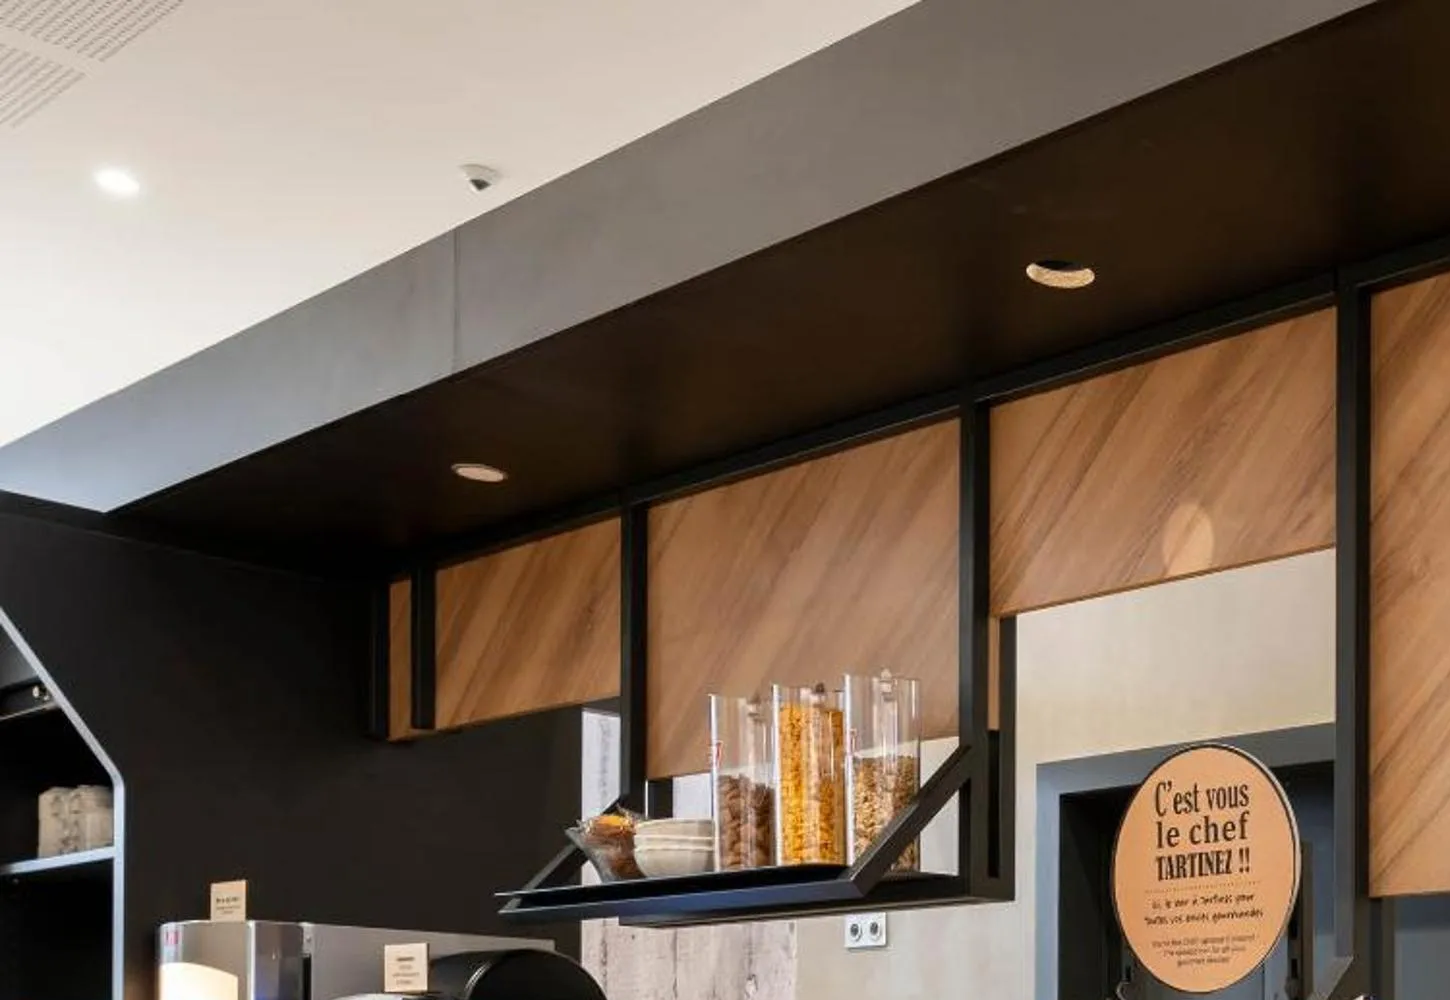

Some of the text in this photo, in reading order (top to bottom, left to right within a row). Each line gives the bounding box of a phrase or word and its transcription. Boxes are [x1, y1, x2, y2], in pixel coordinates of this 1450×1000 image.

[1155, 780, 1250, 817] C'est vous
[1156, 811, 1250, 849] le chef
[1156, 847, 1250, 881] TARTINEZ !!
